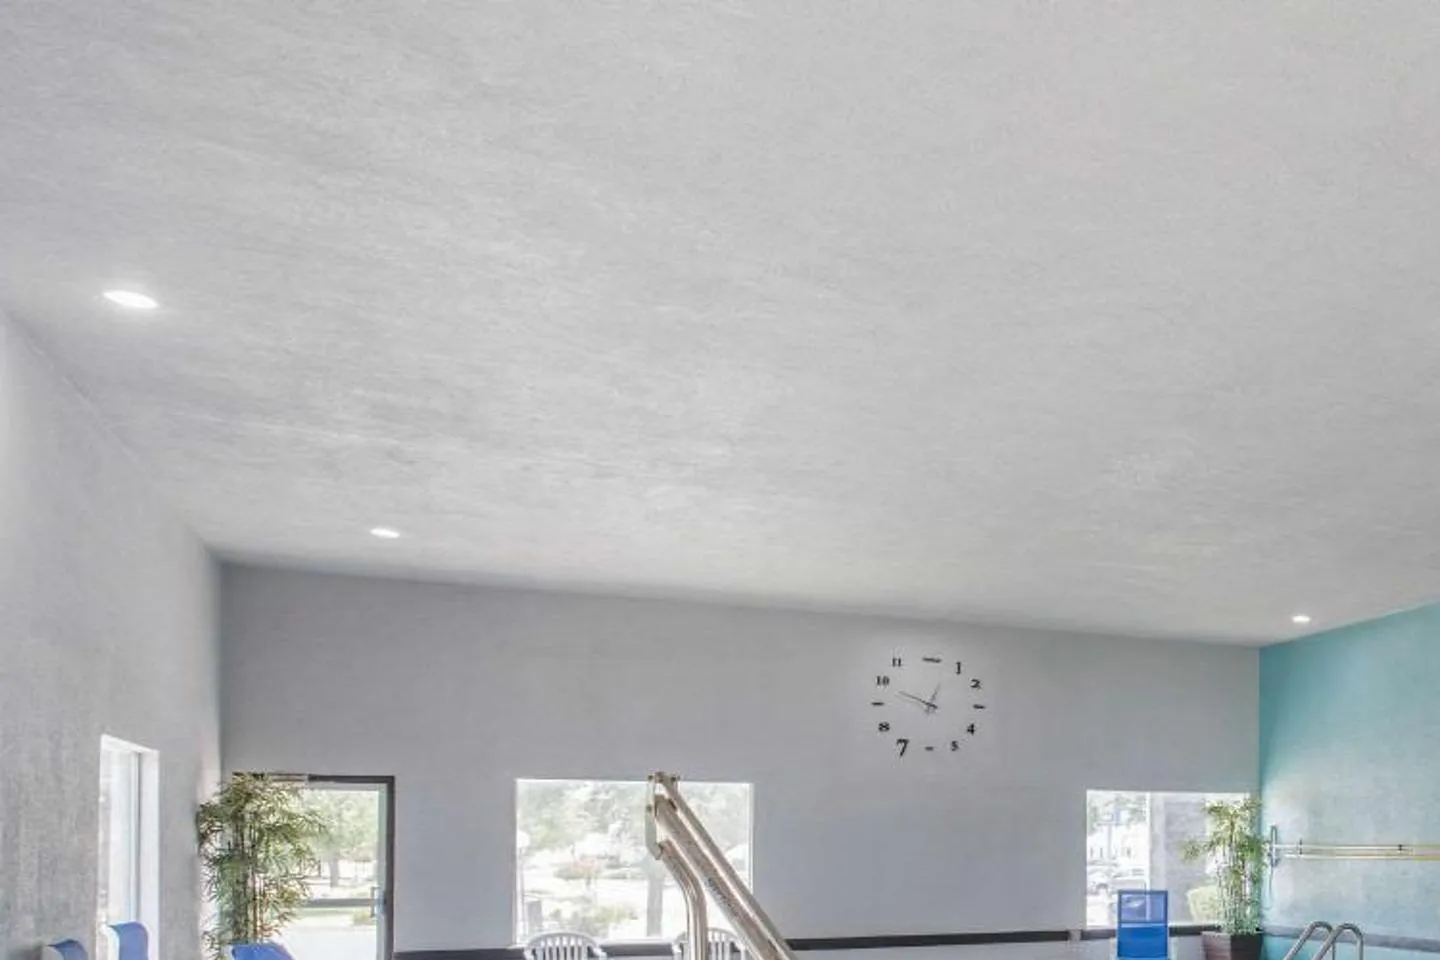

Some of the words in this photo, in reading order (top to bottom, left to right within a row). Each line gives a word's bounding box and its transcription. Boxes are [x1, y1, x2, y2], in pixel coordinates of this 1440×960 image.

[955, 661, 962, 675] 1
[876, 675, 890, 686] 10
[970, 678, 981, 689] 2
[878, 721, 890, 732] 8
[966, 723, 976, 736] 4
[896, 738, 910, 757] 7
[951, 740, 960, 752] 5
